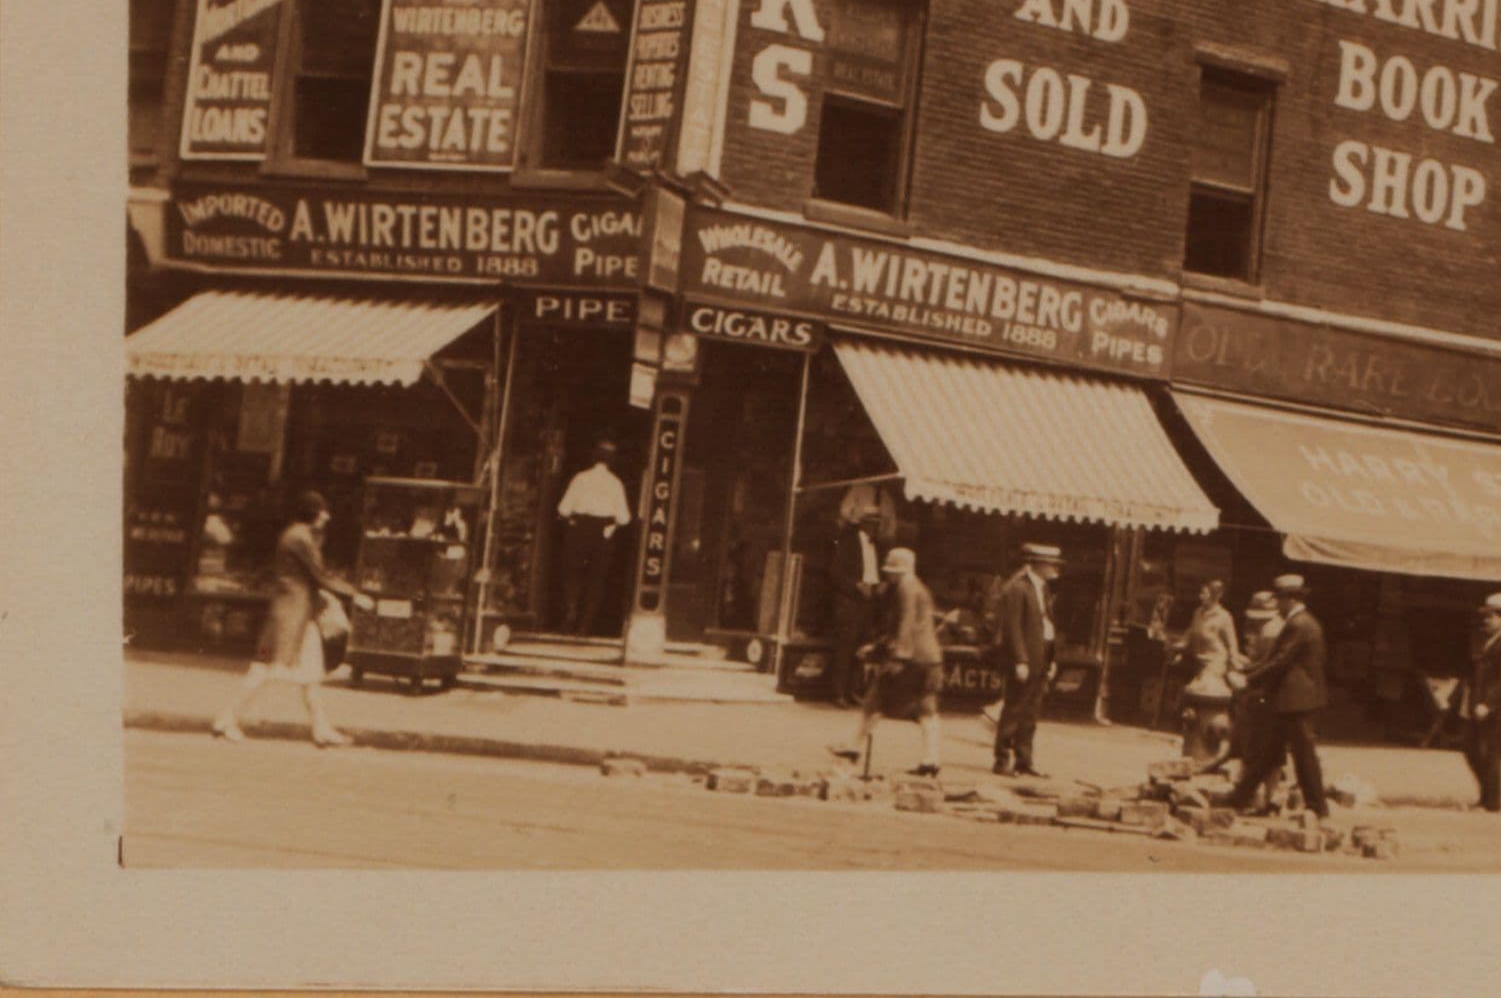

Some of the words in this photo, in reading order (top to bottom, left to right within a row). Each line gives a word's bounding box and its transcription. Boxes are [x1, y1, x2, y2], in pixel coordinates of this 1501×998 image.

[393, 6, 525, 36] WIRTENBERG
[389, 52, 515, 97] REAL
[1335, 39, 1498, 144] BOOK
[191, 105, 267, 145] LOANS
[377, 104, 512, 153] ESTATE
[979, 59, 1148, 159] SOLD
[1329, 140, 1487, 232] SHOP
[176, 193, 287, 233] IMPORTED
[182, 229, 284, 262] DOMESTIC
[309, 249, 464, 275] ESTABLISHED
[701, 256, 787, 299] RETAIL
[690, 306, 813, 347] CIGARS
[831, 293, 993, 338] ESTABLISHED
[1001, 322, 1058, 349] 1888
[1091, 330, 1163, 364] PIPES
[644, 429, 676, 579] CIGARS
